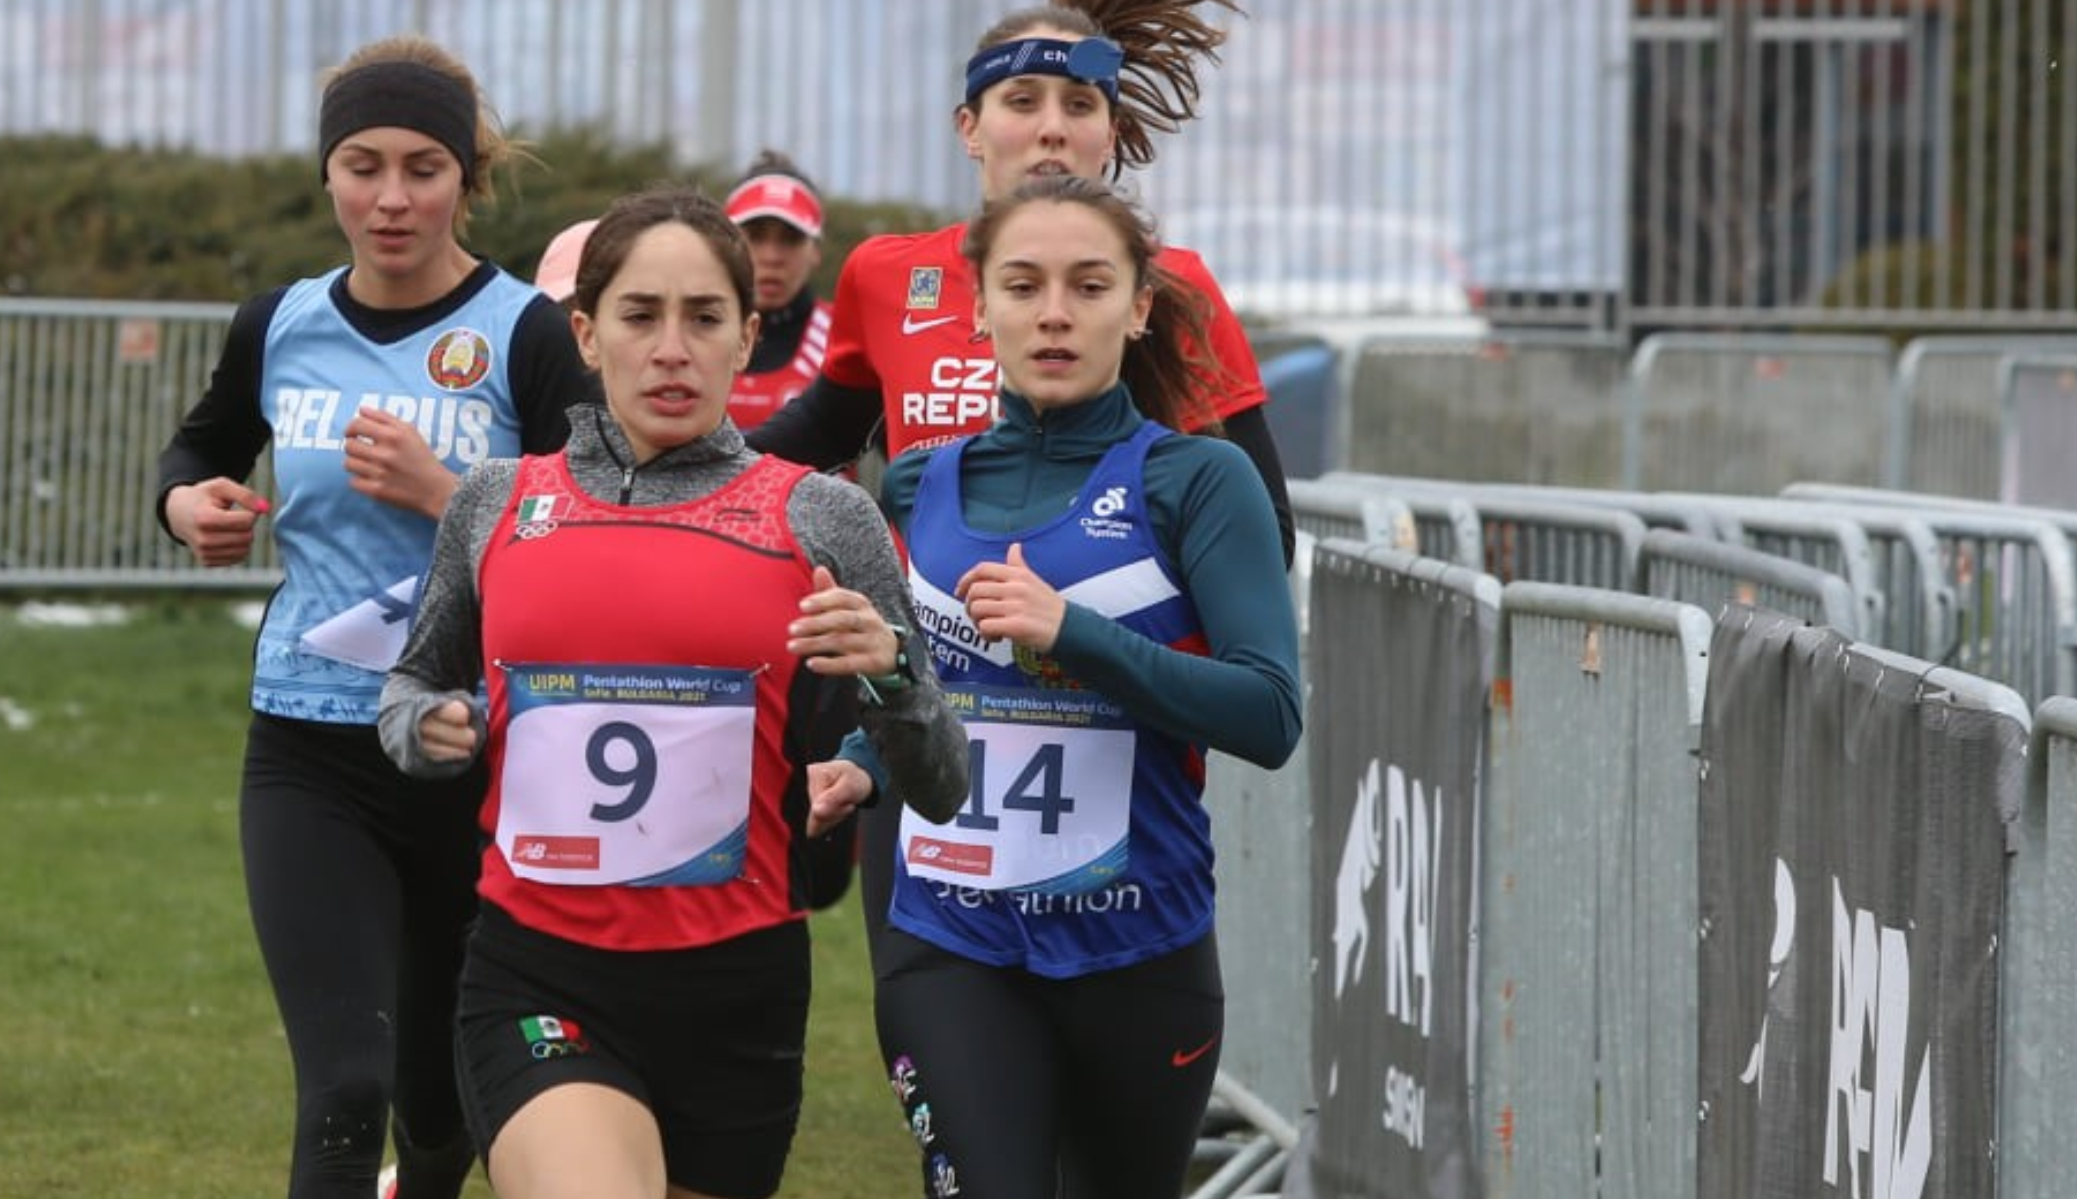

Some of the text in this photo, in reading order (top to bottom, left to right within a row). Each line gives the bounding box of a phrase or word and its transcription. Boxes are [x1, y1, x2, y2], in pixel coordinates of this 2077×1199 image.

[529, 674, 576, 691] UIPM
[583, 674, 742, 693] Pentathlon World Cup
[981, 695, 1052, 711] Pentathlon
[1055, 699, 1096, 713] World
[585, 720, 658, 823] 9
[957, 739, 1075, 834] 14
